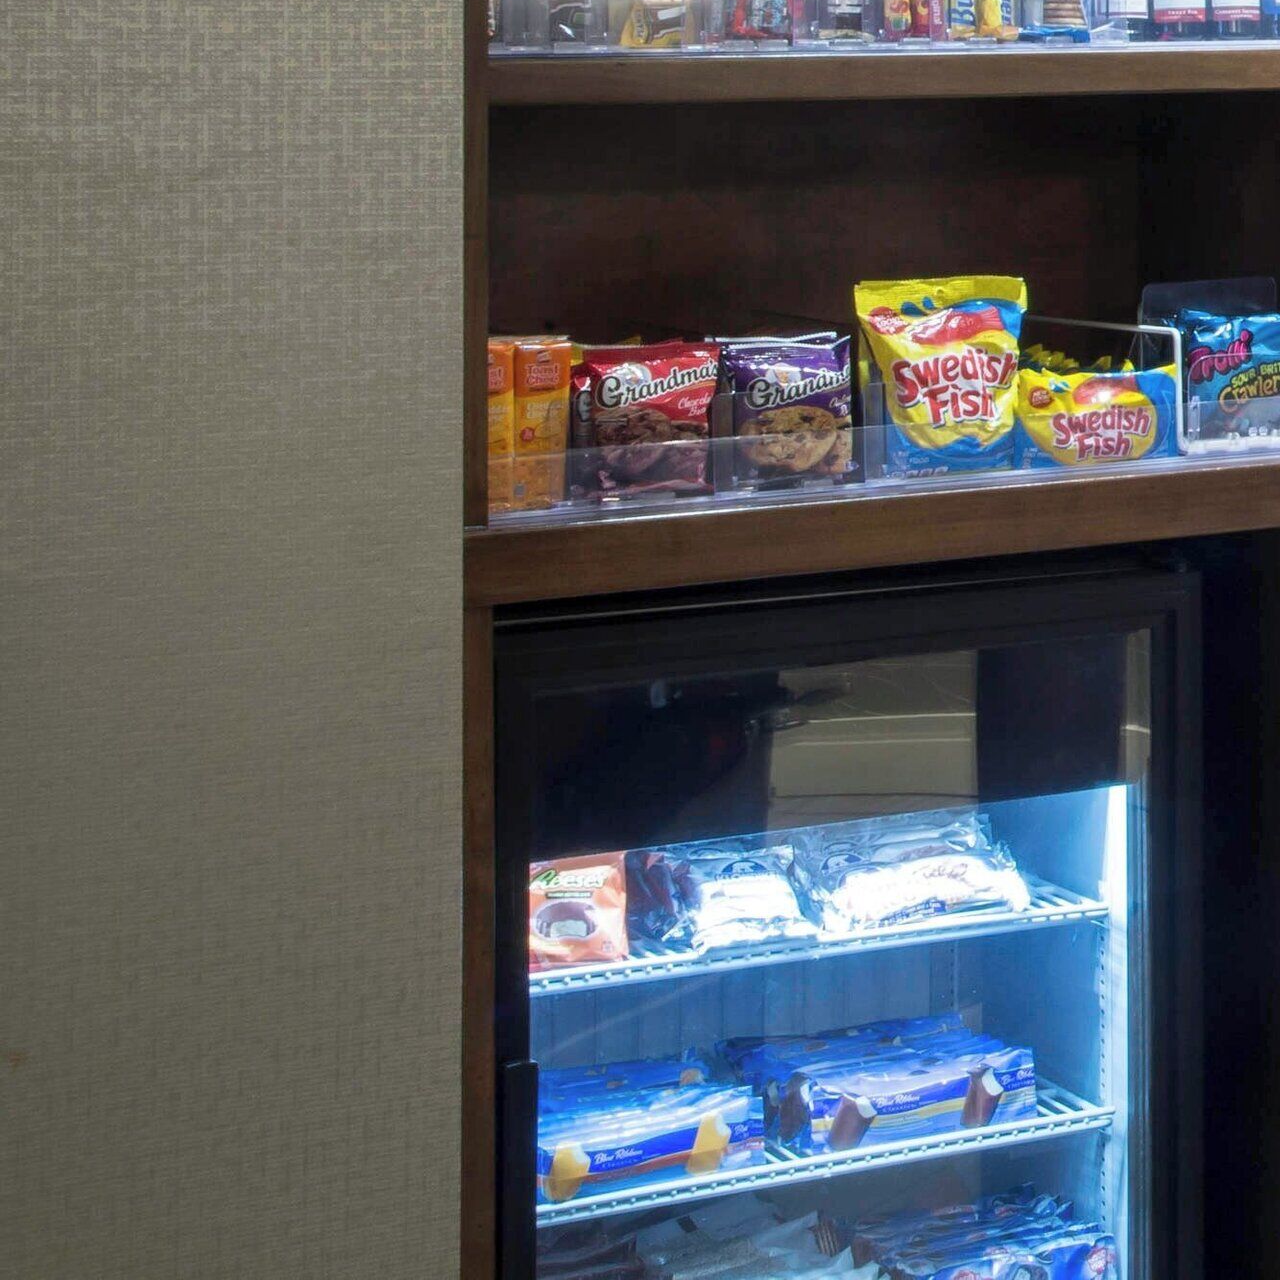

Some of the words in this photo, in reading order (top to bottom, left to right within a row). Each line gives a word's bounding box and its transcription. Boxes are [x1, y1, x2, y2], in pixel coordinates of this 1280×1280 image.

[892, 345, 1018, 407] Swedish
[923, 383, 997, 428] Fish
[1053, 406, 1151, 448] Swedish
[1075, 431, 1133, 462] Fish
